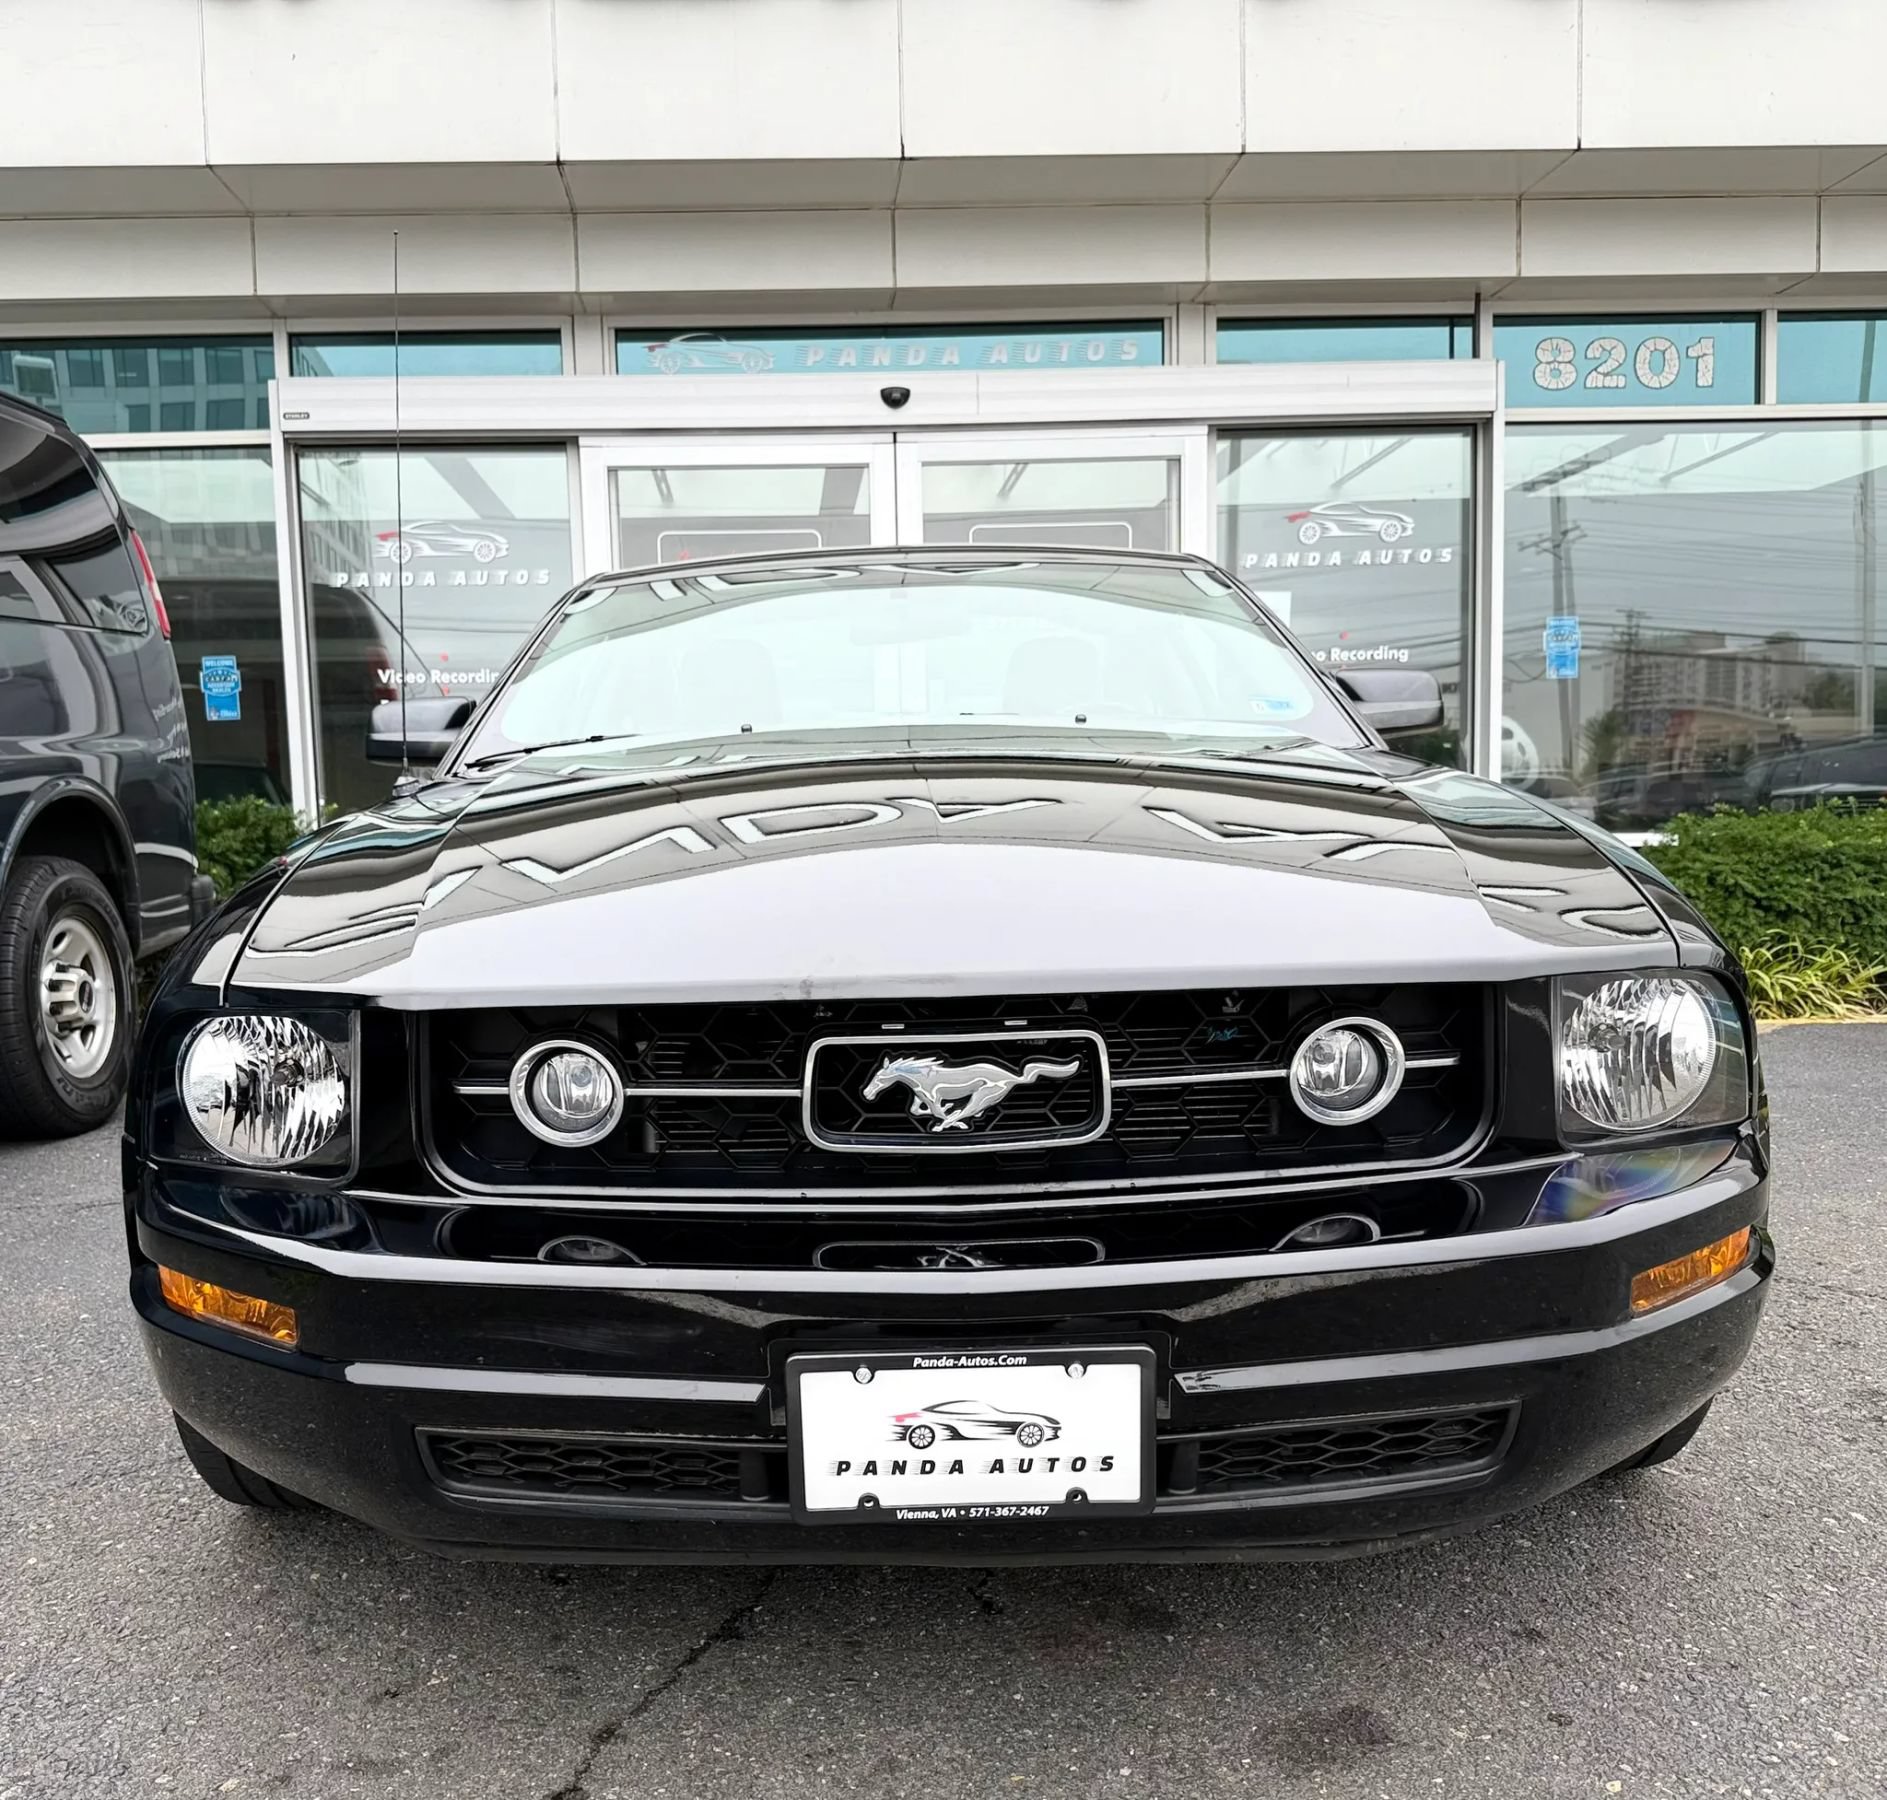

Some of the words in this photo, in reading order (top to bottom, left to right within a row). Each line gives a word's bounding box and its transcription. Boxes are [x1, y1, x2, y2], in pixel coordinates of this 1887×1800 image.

[805, 343, 961, 367] PANDA
[989, 341, 1139, 364] AUTOS
[1532, 335, 1716, 392] 8201
[1245, 551, 1342, 568] PANDA
[1358, 548, 1453, 565] AUTOS
[336, 572, 437, 588] PANDA
[453, 569, 550, 585] AUTOS
[1331, 645, 1409, 662] Recording
[377, 668, 426, 684] Video
[431, 667, 500, 684] Recordin
[912, 1354, 1028, 1369] Panda-Autos.Com
[834, 1459, 965, 1477] PANDA
[988, 1456, 1114, 1474] AUTOS
[896, 1508, 940, 1520] Vienna,
[941, 1508, 957, 1519] VA
[968, 1505, 1050, 1518] 571-367-2467
